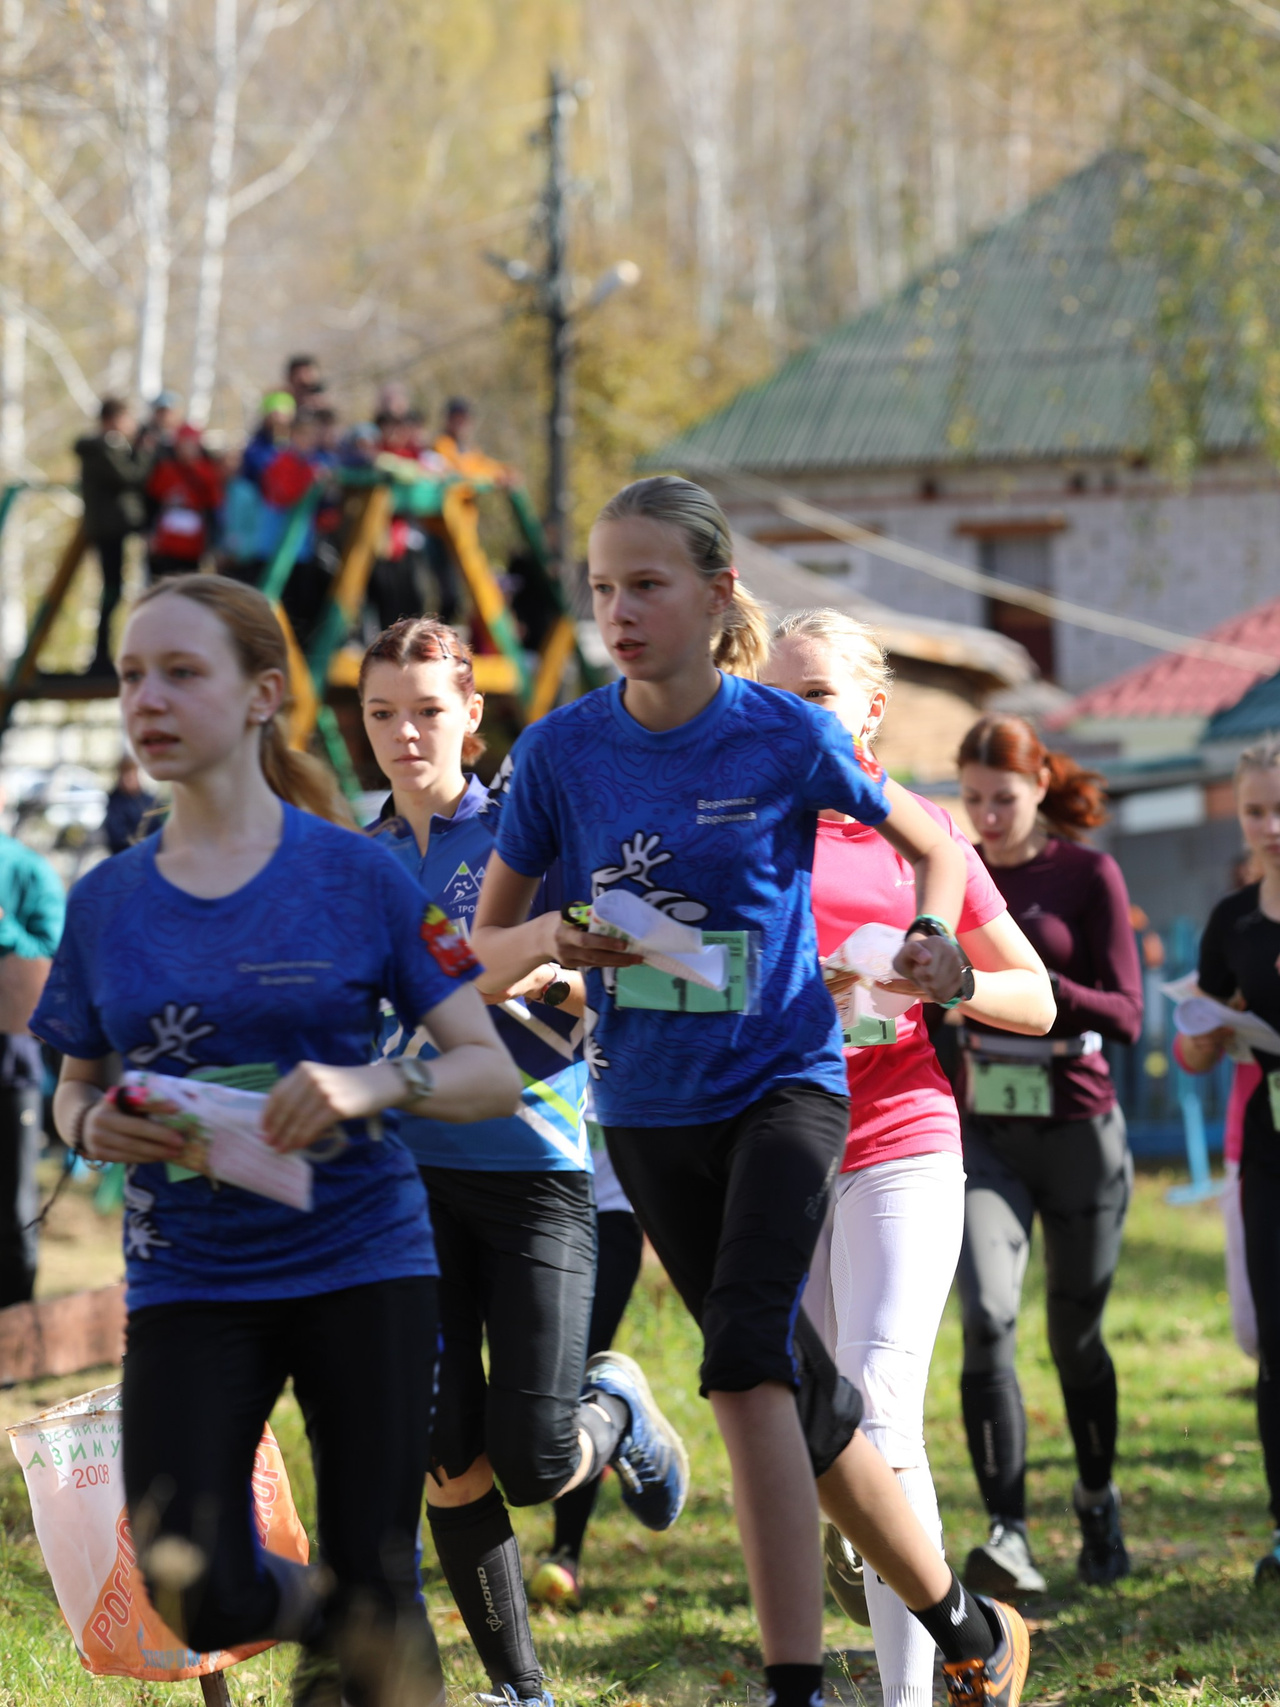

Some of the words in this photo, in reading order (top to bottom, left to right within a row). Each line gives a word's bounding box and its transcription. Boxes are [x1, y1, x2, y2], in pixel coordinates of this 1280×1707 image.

[458, 904, 479, 914] ТРО
[672, 977, 687, 1011] 1
[1003, 1084, 1017, 1111] 3
[26, 1440, 122, 1470] АЗИМУ
[477, 1566, 496, 1614] NORD
